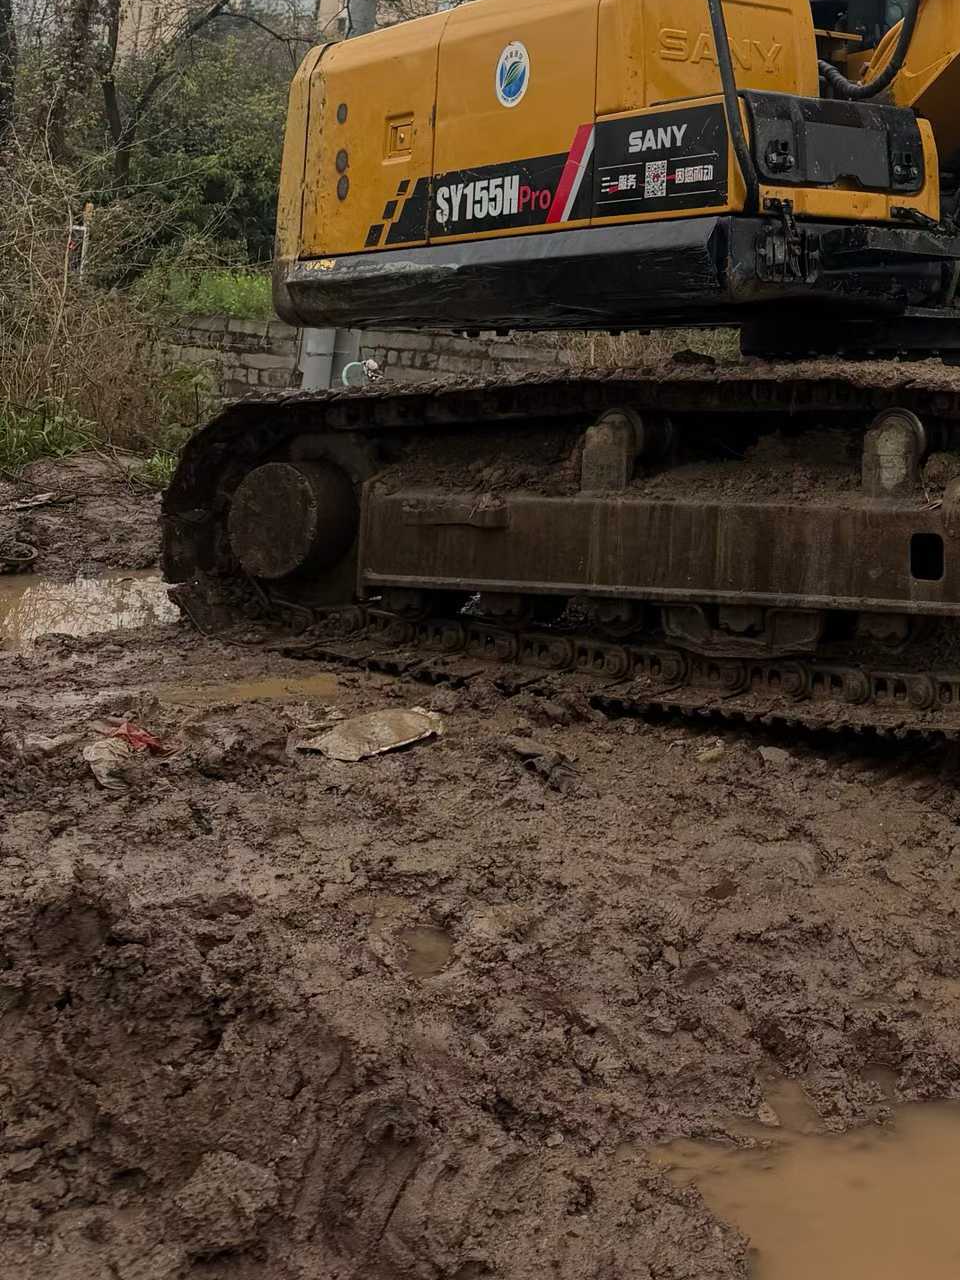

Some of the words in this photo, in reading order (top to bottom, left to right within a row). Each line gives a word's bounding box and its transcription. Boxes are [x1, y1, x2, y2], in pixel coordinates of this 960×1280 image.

[628, 123, 688, 153] SANY
[601, 174, 637, 193] 三一服务
